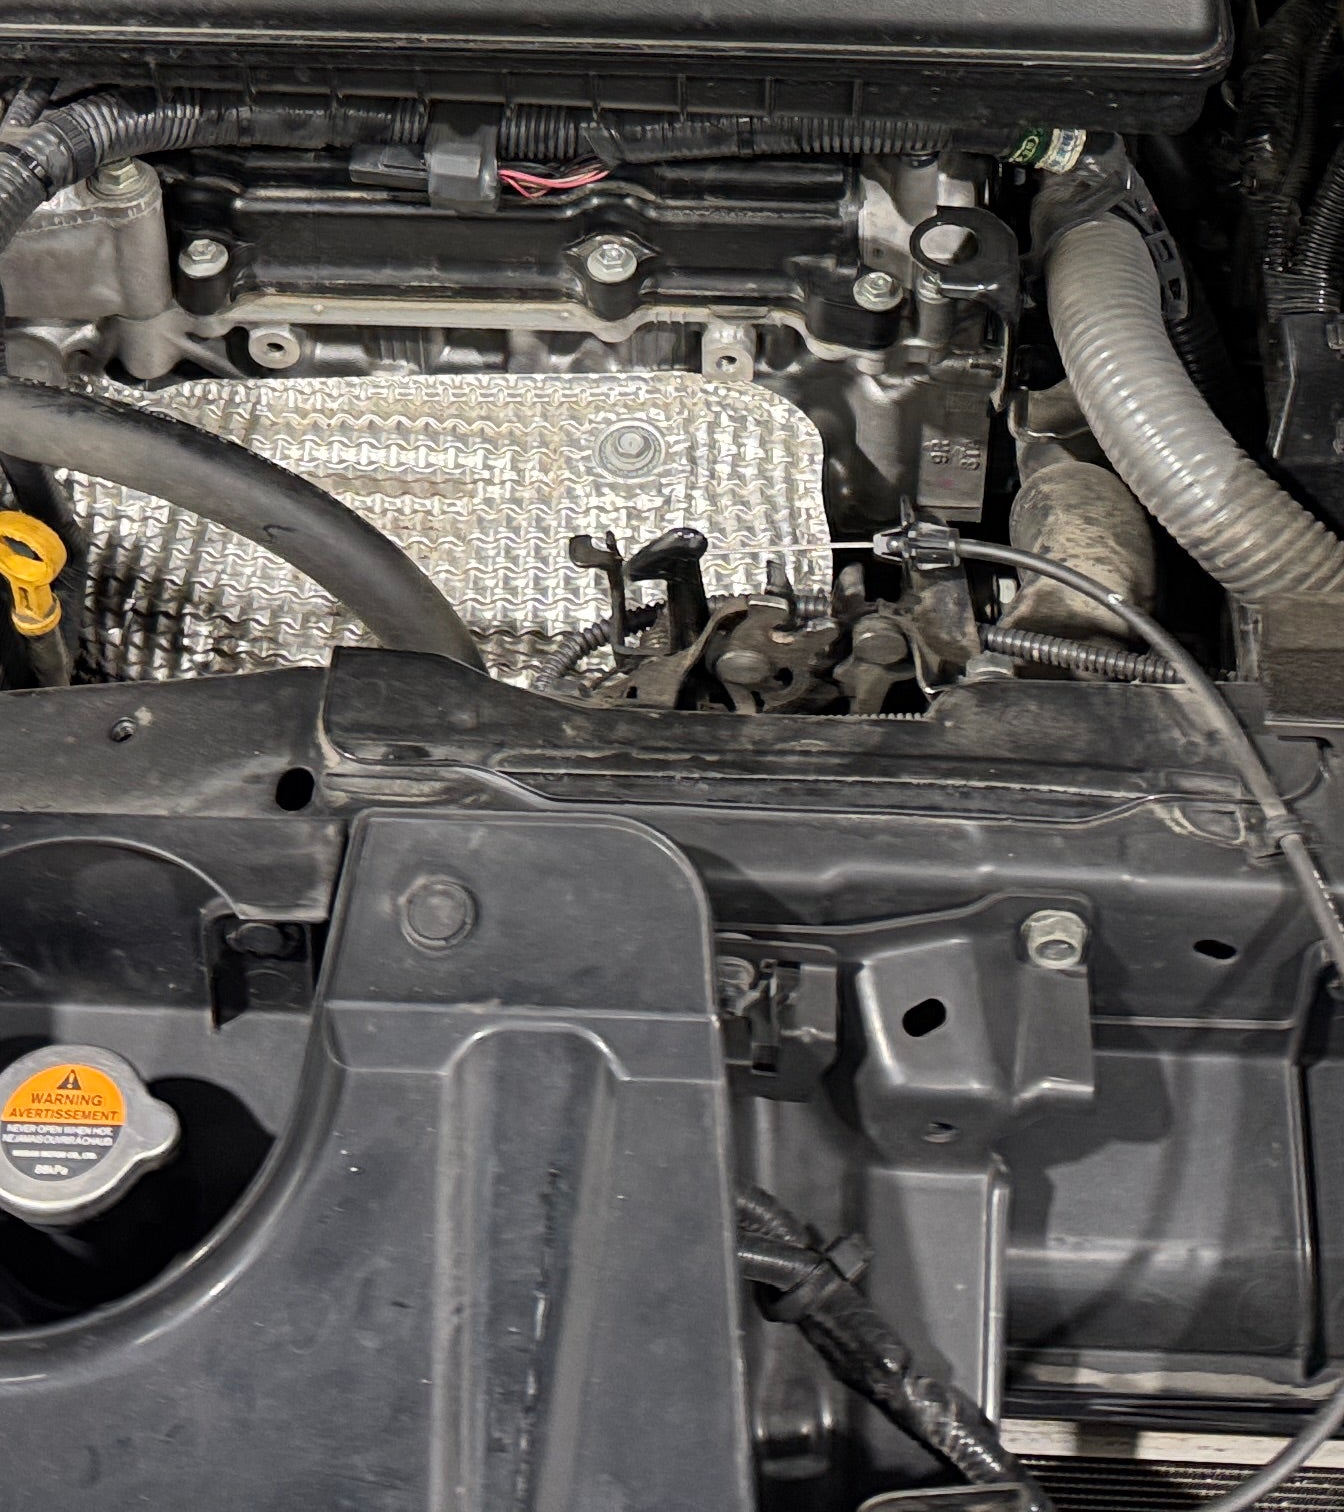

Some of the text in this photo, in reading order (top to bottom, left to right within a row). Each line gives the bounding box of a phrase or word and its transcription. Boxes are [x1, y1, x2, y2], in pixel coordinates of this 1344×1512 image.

[31, 1092, 103, 1107] WARNING
[8, 1108, 118, 1122] AVERTISSEMENT
[6, 1124, 37, 1133] NEVER
[37, 1124, 63, 1134] OPEN
